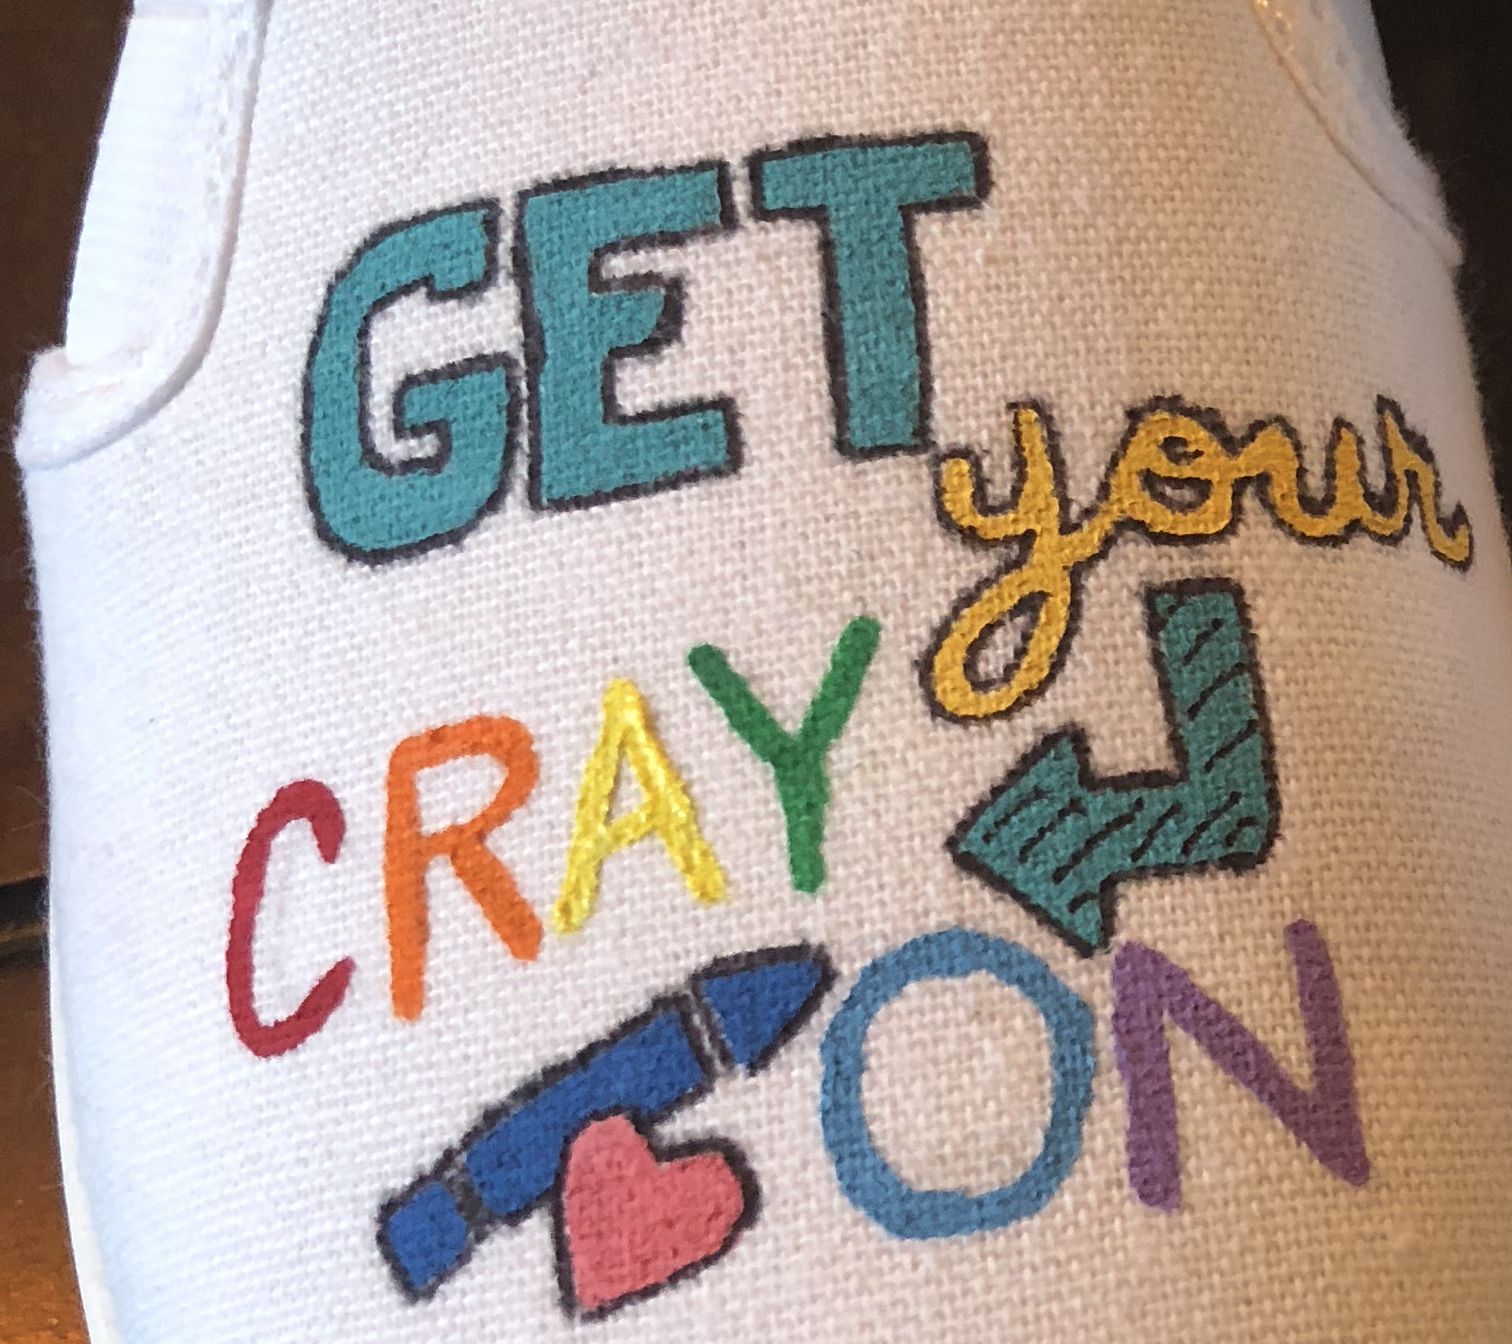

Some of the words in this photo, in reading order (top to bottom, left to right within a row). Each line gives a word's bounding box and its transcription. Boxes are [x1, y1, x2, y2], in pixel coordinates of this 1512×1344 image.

[300, 131, 988, 566] GET
[920, 394, 1474, 726] your
[226, 615, 882, 1059] CRAY
[819, 919, 1371, 1240] ON
